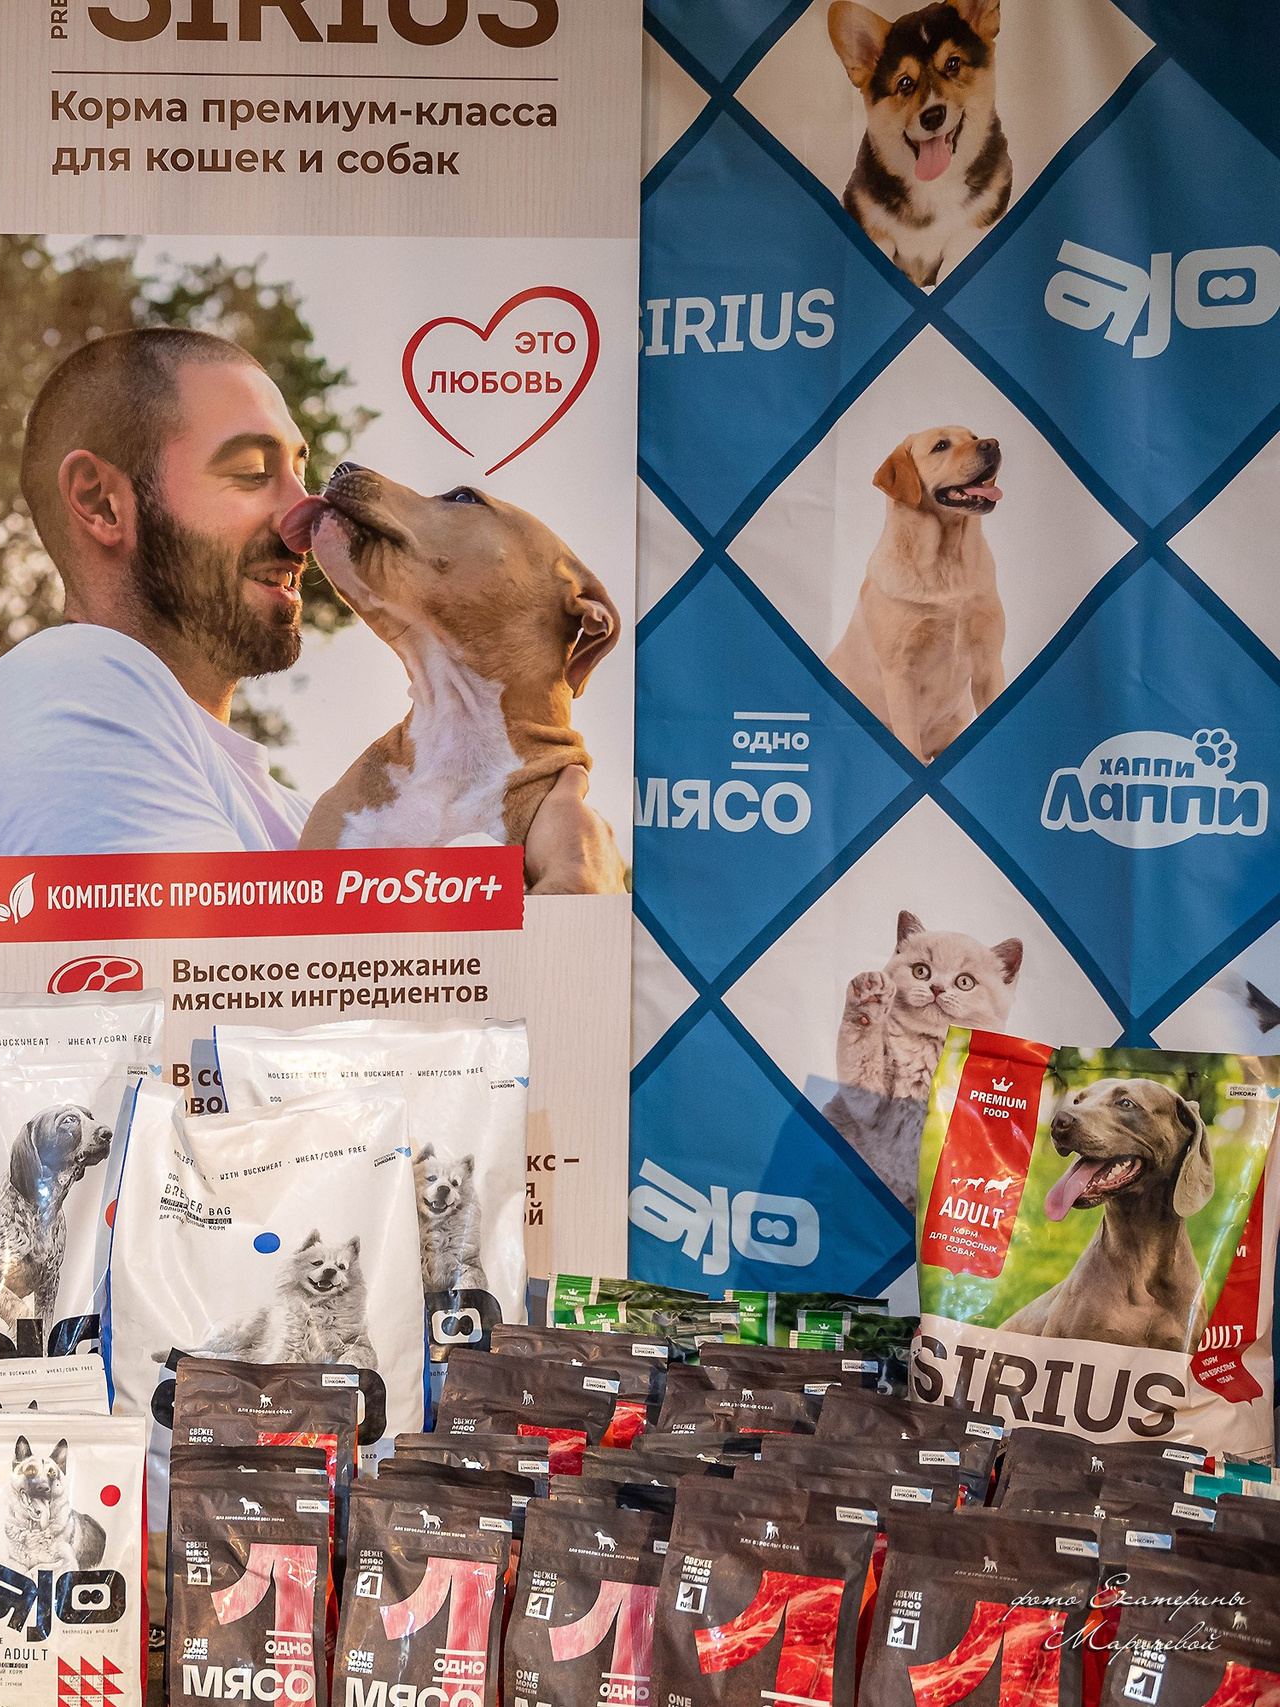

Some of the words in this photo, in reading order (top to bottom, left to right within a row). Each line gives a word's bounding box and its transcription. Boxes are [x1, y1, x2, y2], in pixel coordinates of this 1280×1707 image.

[50, 89, 188, 131] Корма
[202, 96, 559, 132] премиум-класса
[51, 144, 131, 177] для
[145, 143, 286, 174] кошек
[299, 148, 325, 174] и
[336, 141, 460, 176] собак
[514, 330, 577, 356] ЭТО
[427, 369, 564, 396] ЛЮБОВЬ
[46, 881, 164, 911] КОМПЛЕКС
[169, 877, 325, 908] ПРОБИОТИКОВ
[335, 867, 503, 906] ProStor+
[171, 956, 301, 985] Высокое
[305, 953, 483, 986] содержание
[171, 986, 285, 1012] мясных
[290, 983, 490, 1015] ингредиентов
[68, 1035, 128, 1046] WHEAT/CORN
[133, 1034, 153, 1045] FREE
[363, 1070, 405, 1078] BUCKWHEAT
[417, 1069, 462, 1078] WHEAT/CORN
[466, 1066, 484, 1074] FREE
[969, 1089, 1027, 1110] PREMIUM
[982, 1107, 1010, 1119] FOOD
[220, 1171, 239, 1181] WITH
[243, 1160, 282, 1176] BUCKWHEAT
[295, 1150, 344, 1164] WHEAT/CORN
[348, 1145, 368, 1155] FREE
[208, 1206, 232, 1216] BAG
[938, 1195, 1005, 1230] ADULT
[952, 1226, 979, 1239] КОРМ
[929, 1231, 948, 1242] ДЛЯ
[949, 1235, 998, 1254] ВЗРОСЛЫХ
[945, 1244, 976, 1258] СОБАК
[559, 1294, 586, 1303] PREMIUM
[1197, 1325, 1244, 1352] DULT
[912, 1335, 1187, 1438] SIRIUS
[189, 1427, 214, 1436] СВЕЖЕЕ
[684, 1555, 713, 1569] СВЕЖЕЕ
[682, 1565, 711, 1577] МЯСО
[532, 1578, 557, 1587] МЯСО
[894, 1589, 923, 1601] СВЕЖЕЕ
[892, 1600, 922, 1610] МЯСО
[183, 1637, 208, 1648] ONE
[4, 1648, 48, 1661] ADULT
[348, 1649, 374, 1662] ONE
[347, 1659, 373, 1669] MONO
[516, 1669, 540, 1682] ONE
[182, 1664, 315, 1702] МЯСО
[516, 1679, 539, 1689] MONO
[668, 1692, 692, 1707] ONE
